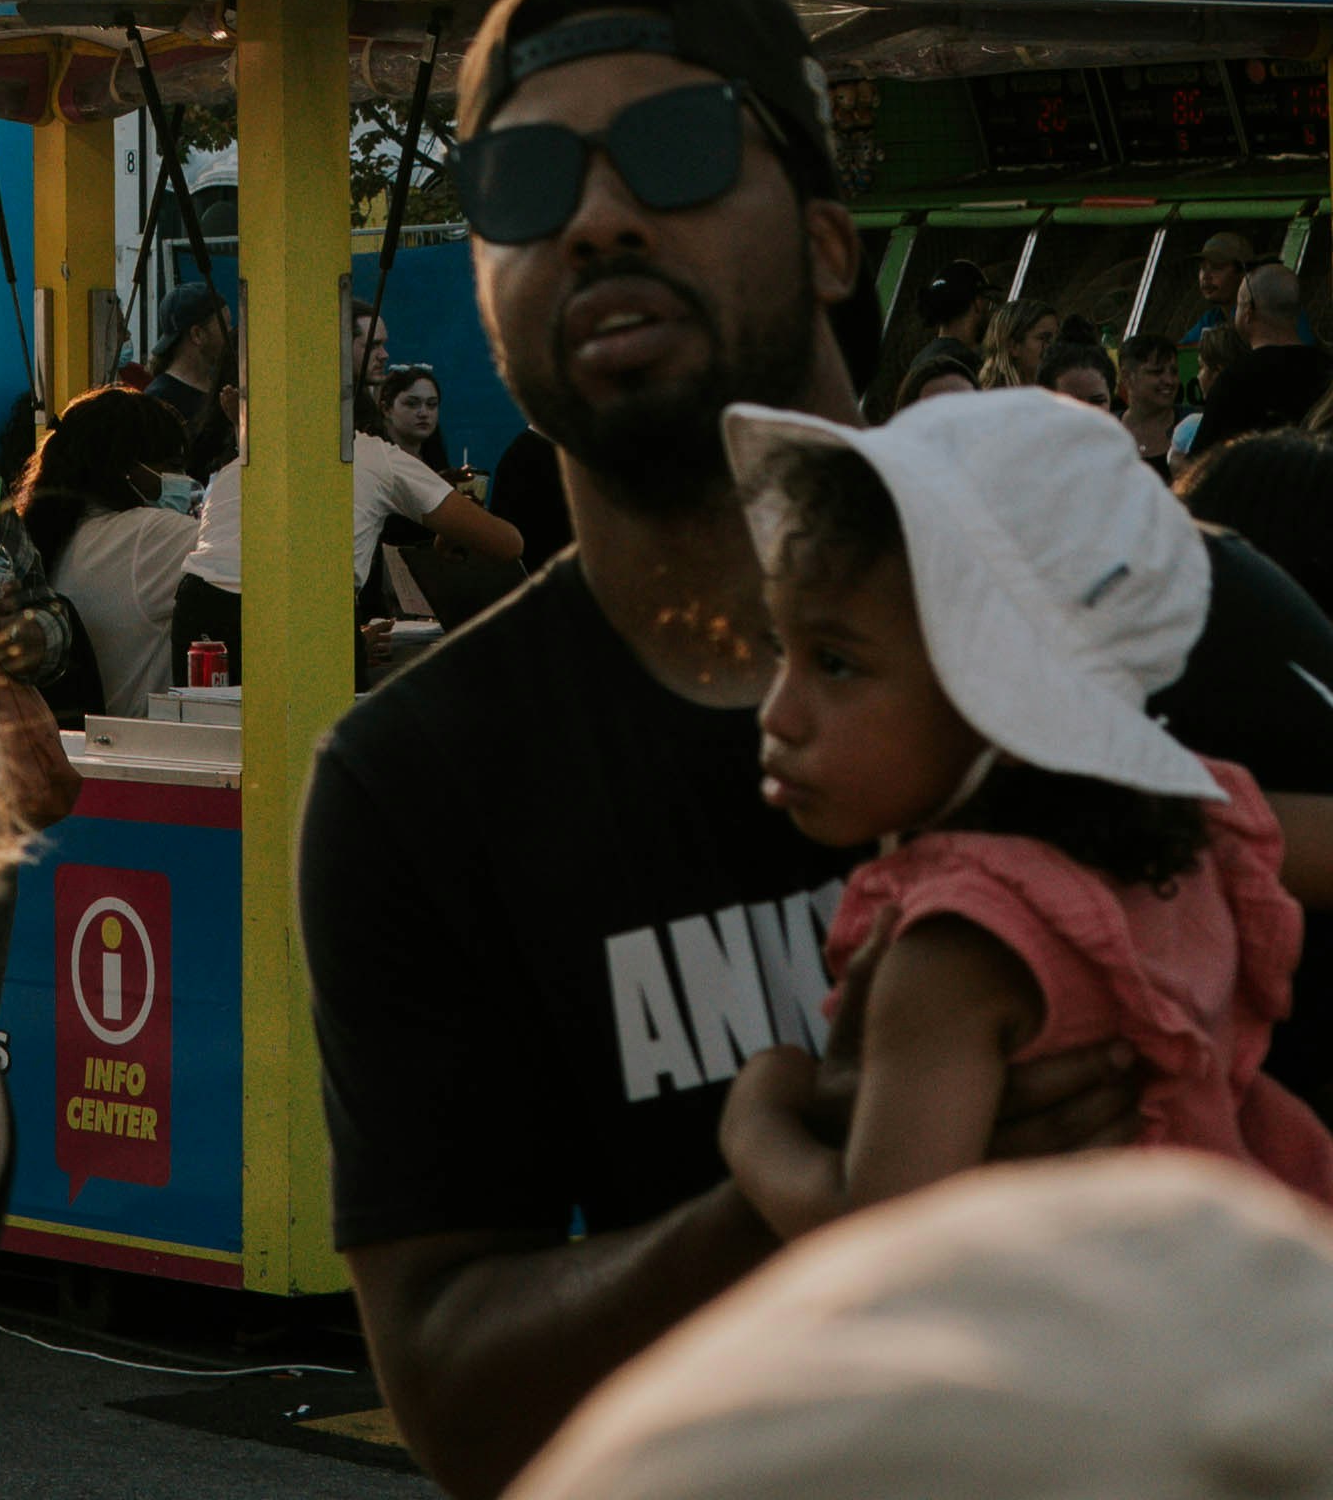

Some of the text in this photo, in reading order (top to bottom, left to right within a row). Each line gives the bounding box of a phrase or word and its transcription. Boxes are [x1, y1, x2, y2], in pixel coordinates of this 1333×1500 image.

[126, 150, 136, 174] 8
[84, 1057, 146, 1097] INFO
[66, 1097, 158, 1143] CENTER
